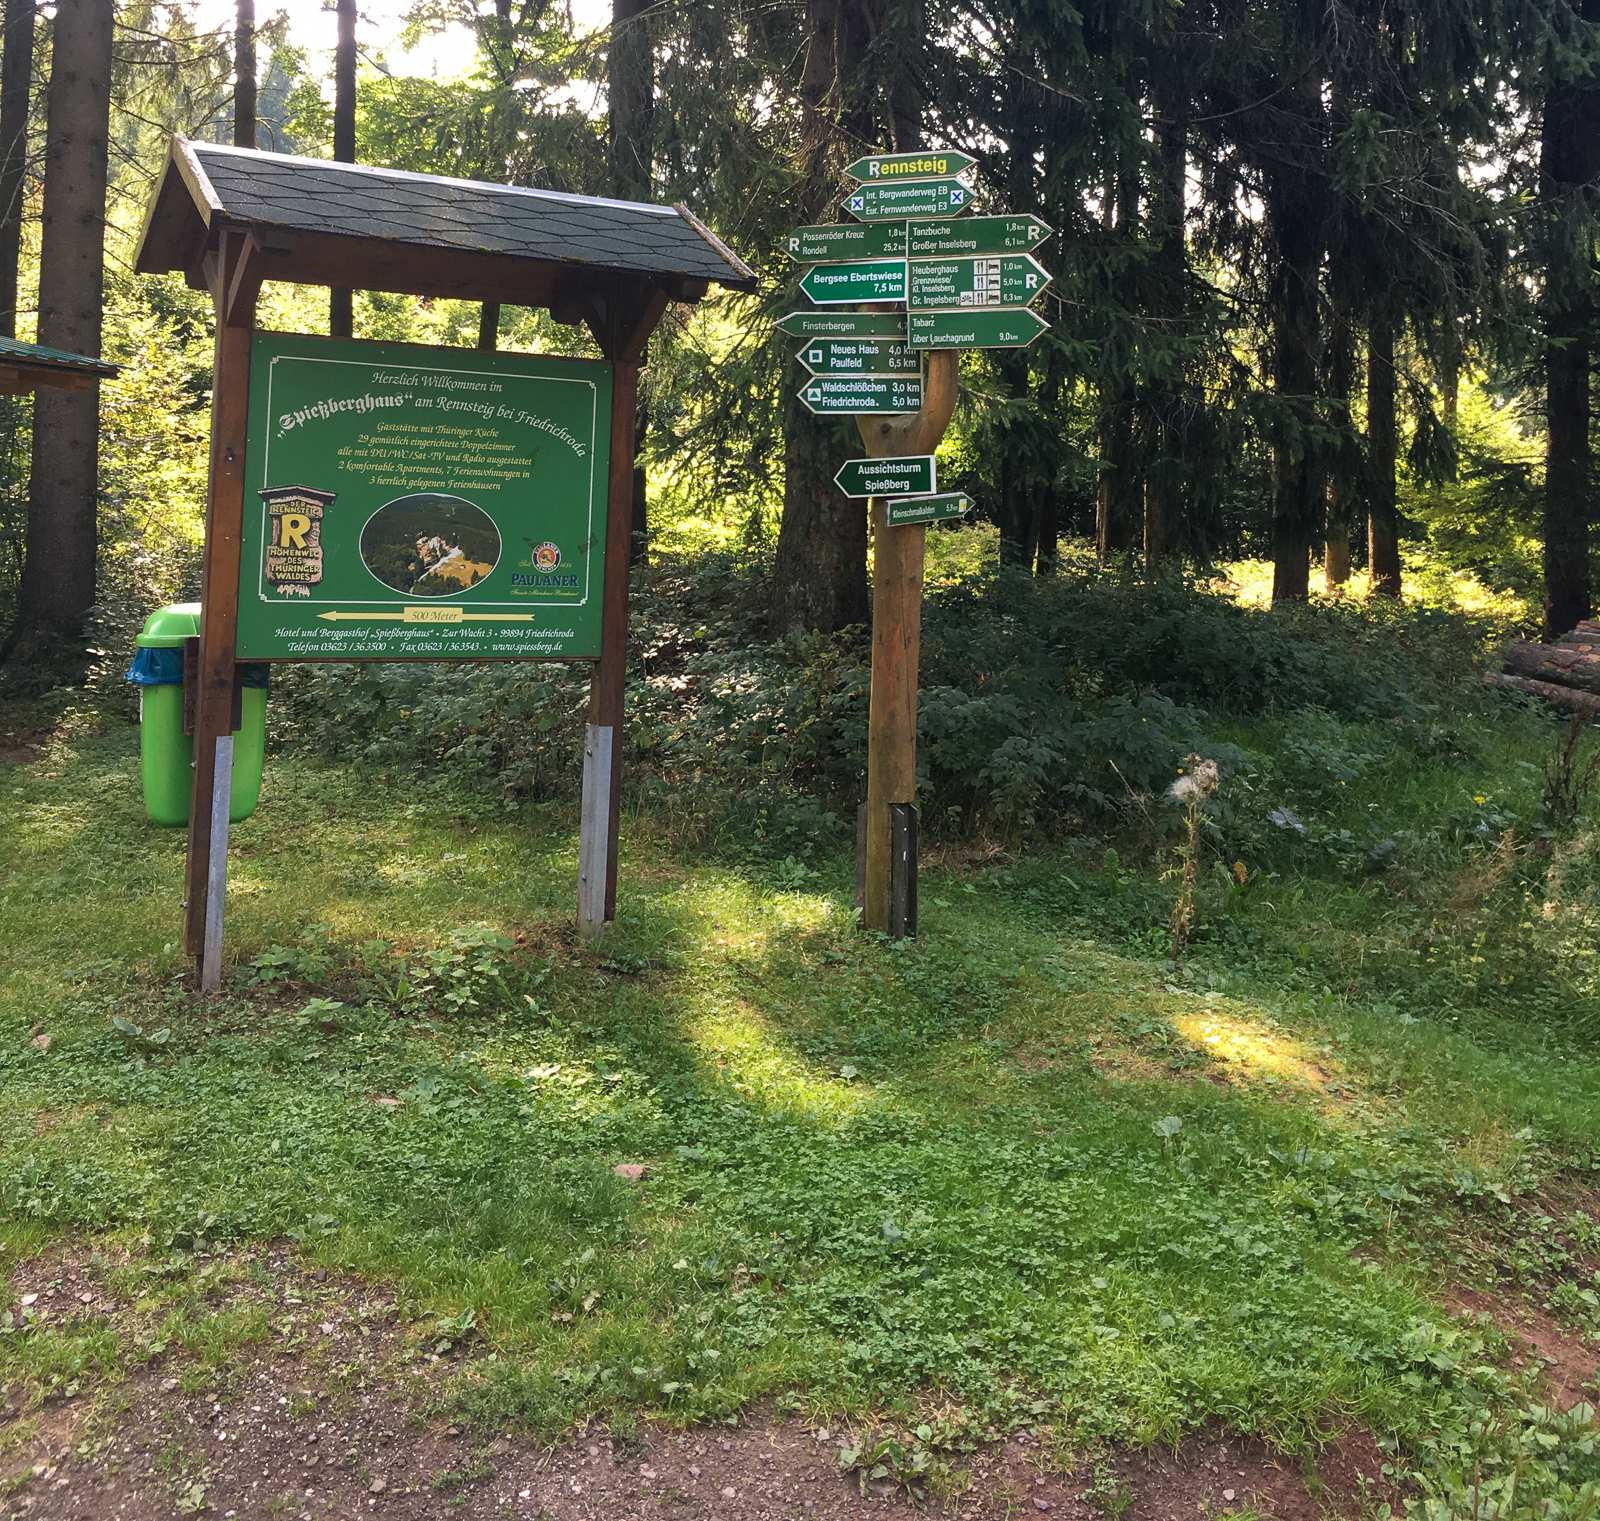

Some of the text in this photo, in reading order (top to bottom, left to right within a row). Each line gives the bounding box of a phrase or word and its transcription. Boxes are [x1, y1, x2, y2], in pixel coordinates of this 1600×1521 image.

[869, 156, 947, 175] Rennsteig
[866, 186, 947, 199] Int. Bergwanderweg EB
[866, 202, 947, 215] Eur. Fernwanderweg E3
[803, 232, 844, 241] Possenröder
[846, 231, 864, 239] Kreuz
[888, 229, 897, 237] 1,8
[913, 227, 950, 236] Tanzbuche
[1006, 223, 1016, 232] 1,8
[1027, 226, 1040, 240] R
[789, 238, 799, 251] R
[803, 246, 827, 255] Rondell
[883, 243, 897, 252] 25,2
[912, 241, 936, 250] Großer
[939, 240, 976, 249] Inselsberg
[1005, 238, 1015, 246] 6,1
[912, 265, 958, 275] Heuberghaus
[1004, 263, 1013, 271] 1,0
[814, 271, 902, 285] Bergsee Ebertswiese
[913, 275, 952, 285] Grenzwiese/
[1003, 278, 1013, 286] 5,0
[1026, 274, 1037, 289] R
[874, 283, 902, 293] 7,5 km
[922, 284, 955, 293] Inselsberg
[913, 296, 922, 305] Gr.
[924, 295, 960, 305] Inselsberg
[1004, 294, 1013, 302] 6,3
[803, 322, 855, 332] Finsterbergen
[913, 319, 934, 327] Tabarz
[913, 334, 928, 343] über
[930, 333, 974, 343] Lauchagrund
[999, 333, 1010, 341] 9,0
[831, 344, 856, 354] Neues
[859, 346, 879, 354] Haus
[888, 345, 901, 355] 4,0
[830, 358, 916, 369] Paulfeld 6,5 km
[371, 371, 503, 392] Herzlich Willkommen im
[822, 382, 919, 393] Waldschlößchen 3,0 km
[822, 397, 919, 407] Friedrichroda 5,0 km
[377, 422, 499, 438] Gaststätte mit Thüringer Küche
[415, 398, 433, 408] am
[436, 396, 495, 419] Rennsteig
[497, 404, 515, 419] bei
[515, 410, 586, 457] Friedrichroda
[358, 435, 515, 452] 29 gemütlich eingerichtete Doppelzimmer
[338, 448, 352, 456] alle
[354, 449, 368, 457] mit
[446, 452, 460, 462] und
[463, 453, 485, 463] Radio
[487, 456, 532, 467] ausgestattet
[338, 461, 530, 480] 2 komfortable Apartments, 7 Ferienwohnungen in
[858, 464, 921, 475] Aussichtsturm
[369, 476, 375, 484] 3
[377, 476, 407, 485] herrlich
[406, 480, 446, 490] gelegenen
[865, 480, 909, 491] Spießberg
[272, 505, 319, 515] RENNSTEIG
[946, 504, 954, 512] 5,9
[281, 513, 311, 549] R
[270, 548, 320, 556] HÖHENWEG
[270, 563, 320, 573] THÜRINGER
[511, 574, 579, 587] PAULANER
[411, 611, 458, 621] 500 Meter
[274, 627, 301, 637] Hotel
[301, 627, 317, 637] und
[320, 627, 371, 640] Berggasthof
[442, 628, 458, 638] Zur
[459, 628, 485, 638] Wacht
[486, 629, 492, 638] 3
[500, 629, 524, 638] 99894
[525, 628, 574, 639] Friedrichroda
[288, 642, 322, 654] Telefon
[398, 642, 417, 653] Fax
[492, 642, 563, 654] www.spiessberg.de
